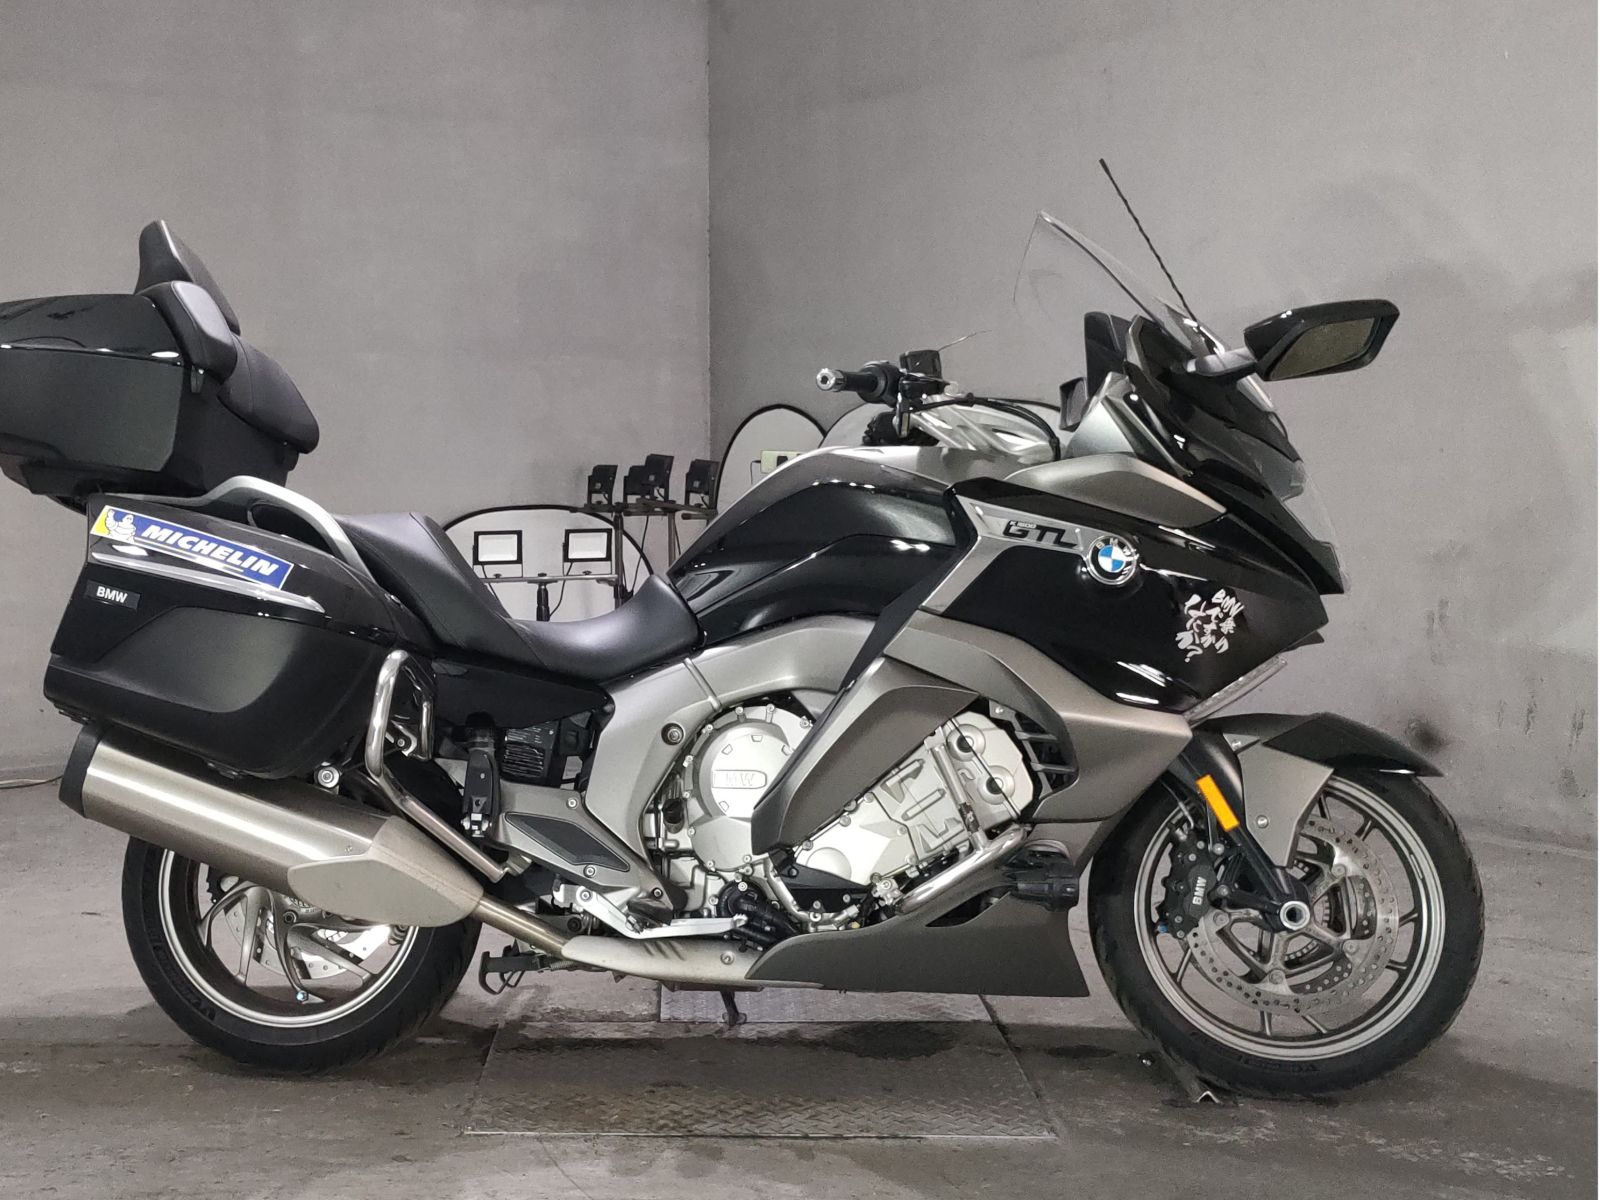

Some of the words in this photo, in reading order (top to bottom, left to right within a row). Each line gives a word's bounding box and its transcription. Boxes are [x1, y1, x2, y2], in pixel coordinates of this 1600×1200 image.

[1003, 520, 1077, 549] GTL
[141, 525, 279, 576] MICHELIN
[96, 586, 128, 604] BMW
[1192, 876, 1207, 905] BMW
